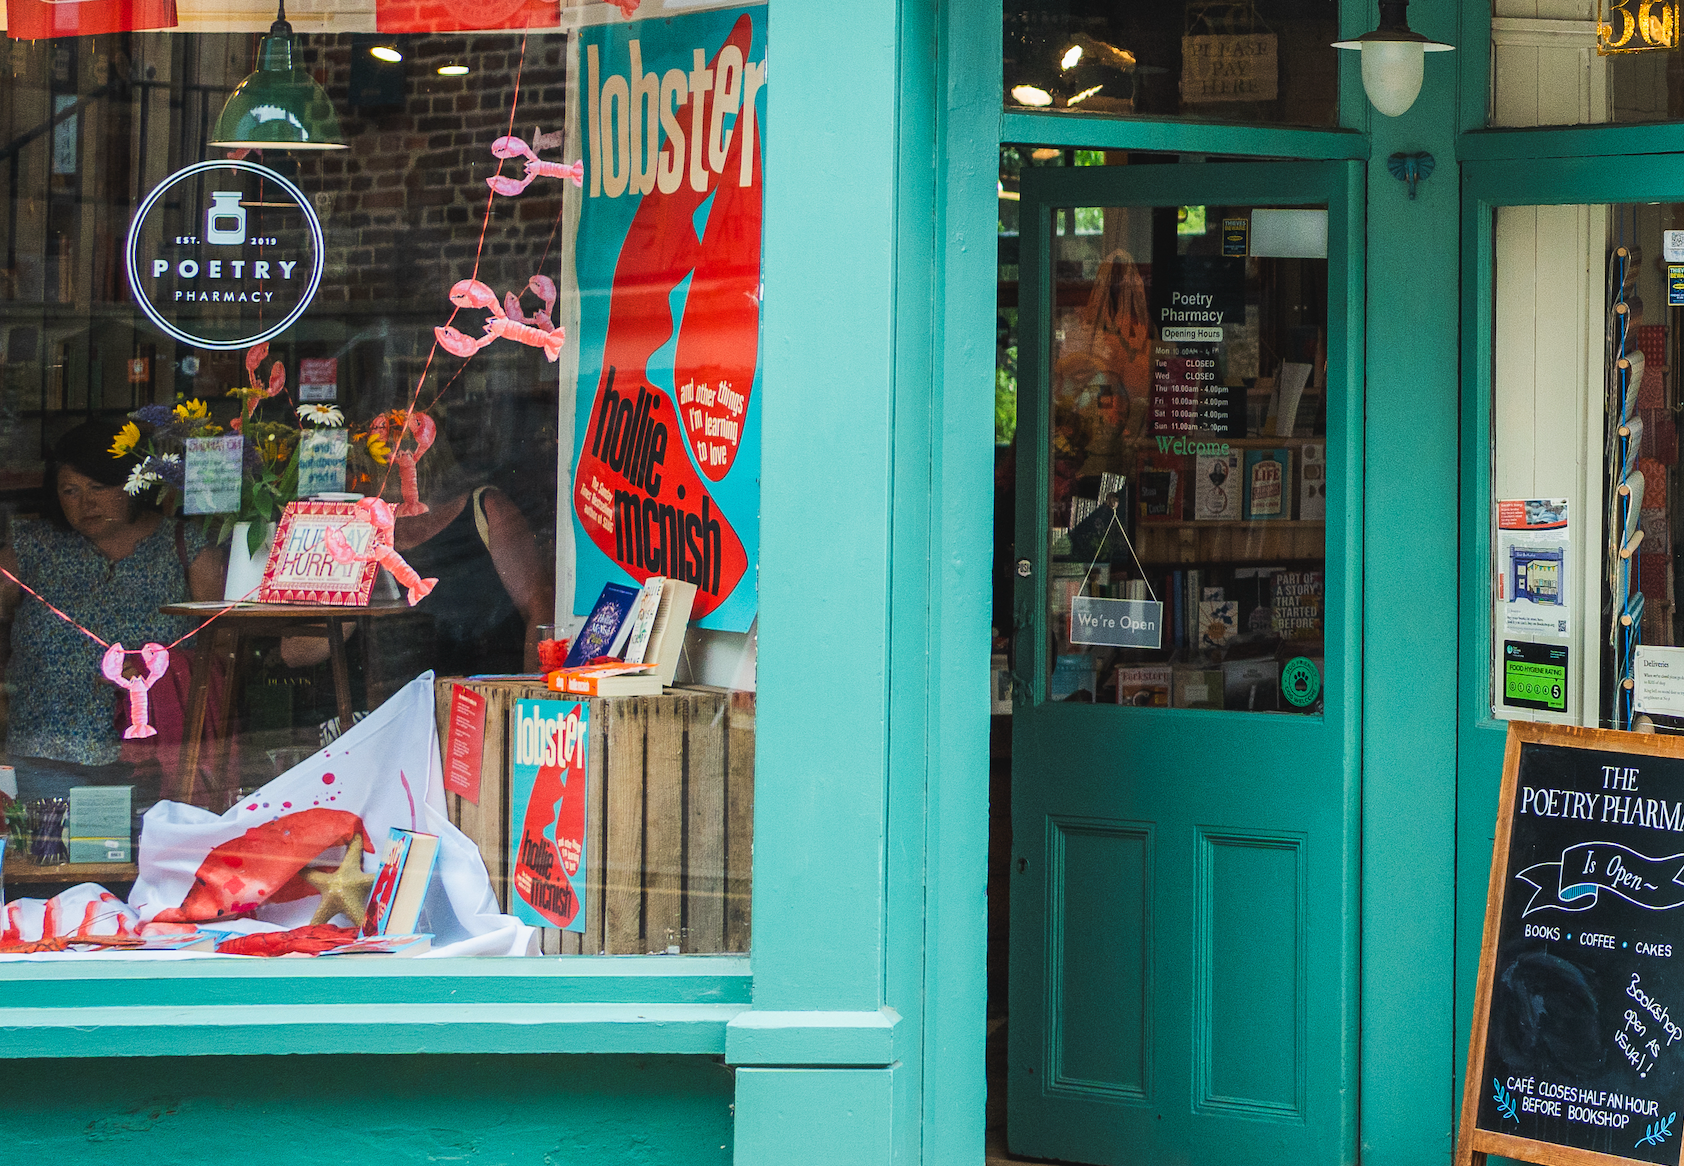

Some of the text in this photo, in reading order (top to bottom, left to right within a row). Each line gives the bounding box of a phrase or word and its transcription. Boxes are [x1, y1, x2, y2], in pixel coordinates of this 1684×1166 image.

[587, 39, 767, 198] lobster
[175, 236, 277, 246] EST. 2019
[153, 259, 297, 279] POETRY
[174, 290, 274, 303] PHARMACY
[1172, 291, 1214, 308] Poetry
[1161, 308, 1225, 325] Pharmacy
[1164, 328, 1221, 339] Opening Hours
[1155, 346, 1171, 355] Mon
[1155, 359, 1215, 368] Tue CLOSED
[1154, 372, 1215, 381] Wed CLOSED
[680, 378, 745, 417] and other things
[1154, 384, 1229, 395] Thu 10.00am 4.00pm
[1154, 397, 1229, 407] Fri 10.00am 4.00pm
[1154, 409, 1229, 420] Sat 10.00am 4.00pm
[591, 365, 668, 498] hollie
[689, 407, 739, 446] I'm learning
[1154, 422, 1198, 431] Sun 11.00am
[697, 440, 727, 467] to love
[1155, 435, 1230, 456] Welcome
[614, 484, 722, 596] mcnish
[1276, 572, 1315, 585] PART OF
[1285, 584, 1315, 596] STORY
[1275, 596, 1301, 607] THAT
[1275, 606, 1318, 618] STARTED
[1077, 612, 1156, 634] We're Open
[1278, 617, 1315, 629] BEFORE
[1643, 659, 1669, 668] Deliveries
[516, 704, 587, 769] lobster
[1601, 765, 1640, 792] THE
[1519, 786, 1599, 821] POETRY
[522, 830, 554, 881] hollie
[1582, 850, 1642, 892] Is Open
[530, 876, 572, 920] mcnish
[1524, 924, 1673, 957] BOOKS COFFEE CAKES
[1625, 972, 1683, 1047] Bookshop
[1506, 1076, 1659, 1117] CAFÉ CLOSES HALF AN HOUR
[1521, 1096, 1630, 1129] BEFORE BOOKSHOP
